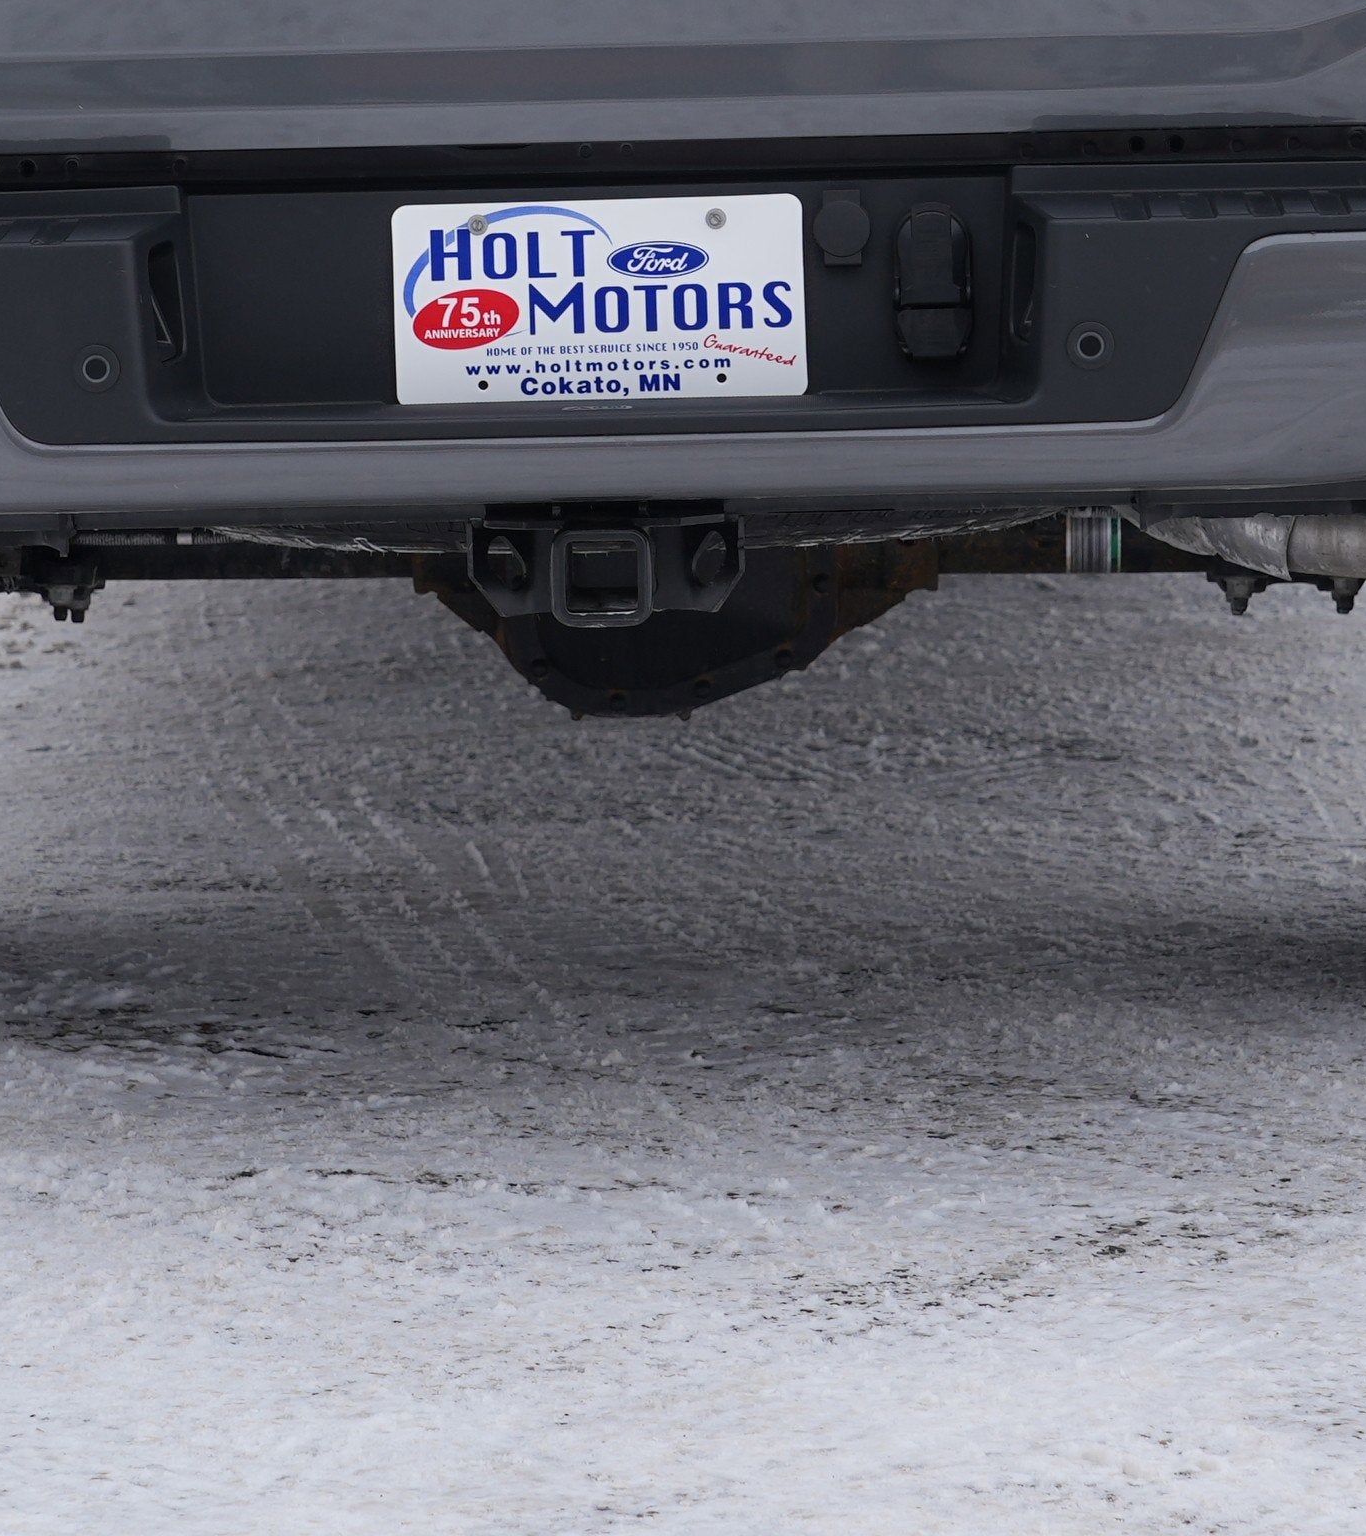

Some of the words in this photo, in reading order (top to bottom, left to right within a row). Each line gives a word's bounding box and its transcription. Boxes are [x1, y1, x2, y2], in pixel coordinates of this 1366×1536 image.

[430, 228, 595, 281] HOLT
[627, 246, 689, 272] Ford
[437, 296, 501, 328] 75th
[528, 281, 793, 336] MOTORS
[424, 327, 501, 340] ANNIVERSARY
[486, 347, 517, 357] HOME
[520, 346, 533, 356] OF
[537, 345, 556, 355] THE
[559, 344, 584, 354] BEST
[588, 343, 632, 353] SERVICE
[636, 342, 667, 352] SINCE
[672, 341, 699, 351] 1950
[703, 333, 797, 366] Guaranteed
[465, 357, 731, 376] www.holtmotors.com
[520, 376, 630, 396] Cokato,
[639, 373, 681, 392] MN
